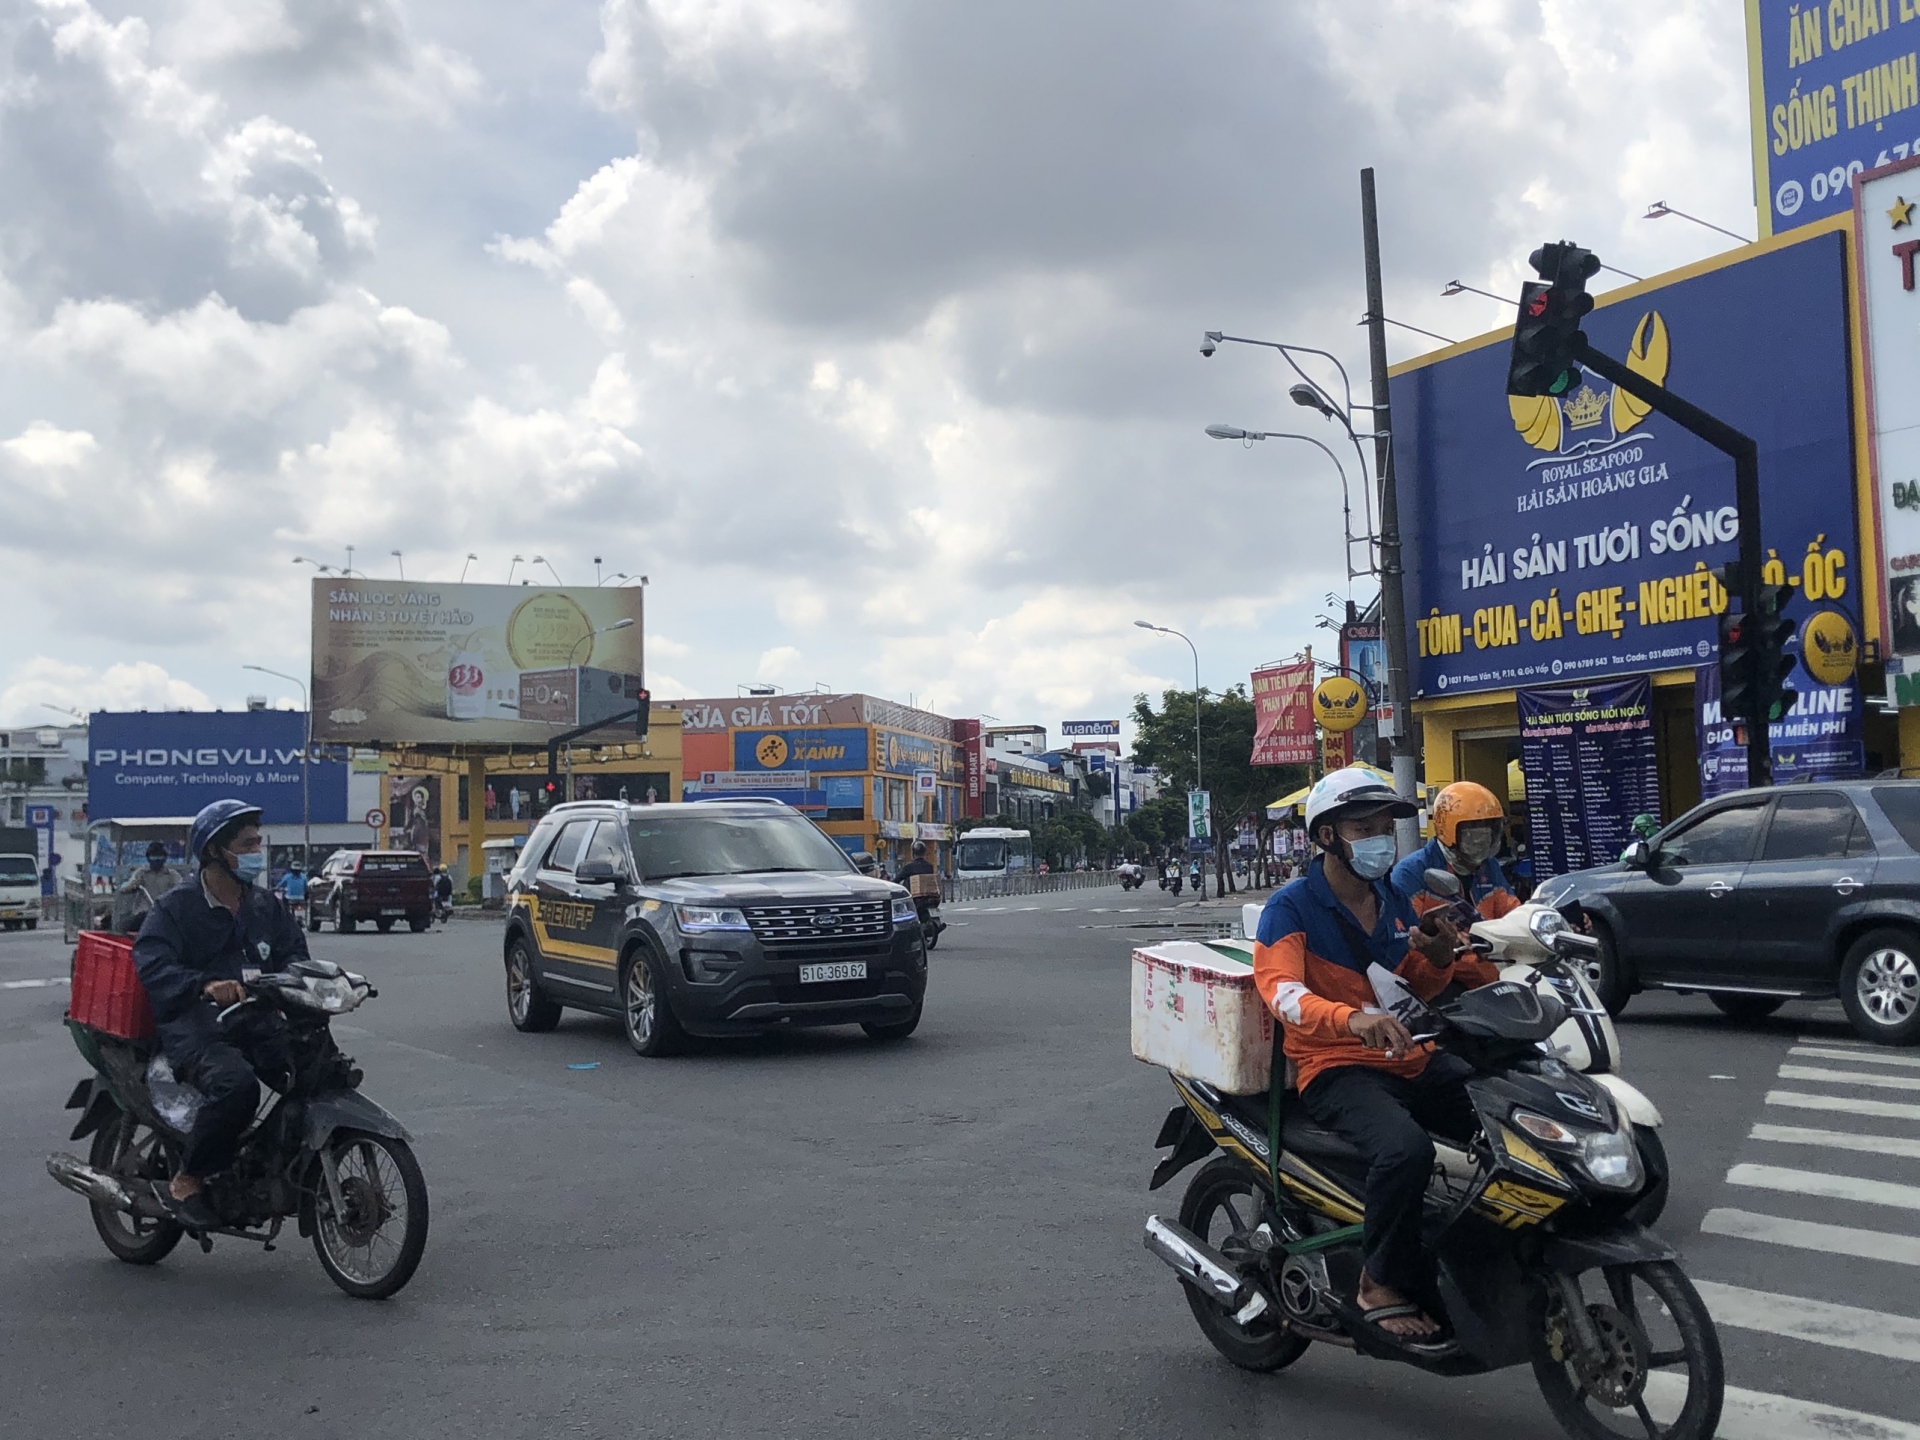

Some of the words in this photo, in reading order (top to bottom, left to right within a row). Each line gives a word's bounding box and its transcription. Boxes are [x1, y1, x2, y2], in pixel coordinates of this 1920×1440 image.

[1789, 4, 1823, 68] ĂN
[1773, 77, 1838, 156] SỐNG
[1842, 52, 1919, 132] THỊNH
[1542, 464, 1582, 484] ROYAL
[1583, 447, 1643, 474] SEAFOOD
[1581, 470, 1636, 499] HOÀNG
[1639, 462, 1670, 485] GIA
[1461, 543, 1506, 589] HẢI
[1513, 533, 1567, 580] SẢN
[1573, 522, 1640, 568] TƯƠI
[1650, 494, 1739, 554] SỐNG
[1416, 607, 1461, 658] TÔM
[1474, 604, 1519, 649] CUA
[1530, 588, 1564, 641] CÁ
[1803, 533, 1846, 601] ỐC
[1563, 660, 1576, 670] 090
[1612, 655, 1624, 664] Tax
[731, 701, 775, 727] GIÁ
[779, 697, 822, 725] TỐT
[1822, 717, 1847, 735] PHÍ
[792, 745, 845, 760] XANH
[969, 752, 978, 775] MART
[115, 773, 179, 785] Computer,
[181, 772, 252, 785] Technology
[255, 773, 265, 783] &
[268, 773, 300, 783] More
[969, 776, 978, 798] BIBO
[536, 900, 595, 930] SHERIFF
[802, 964, 864, 980] 51G-369.62
